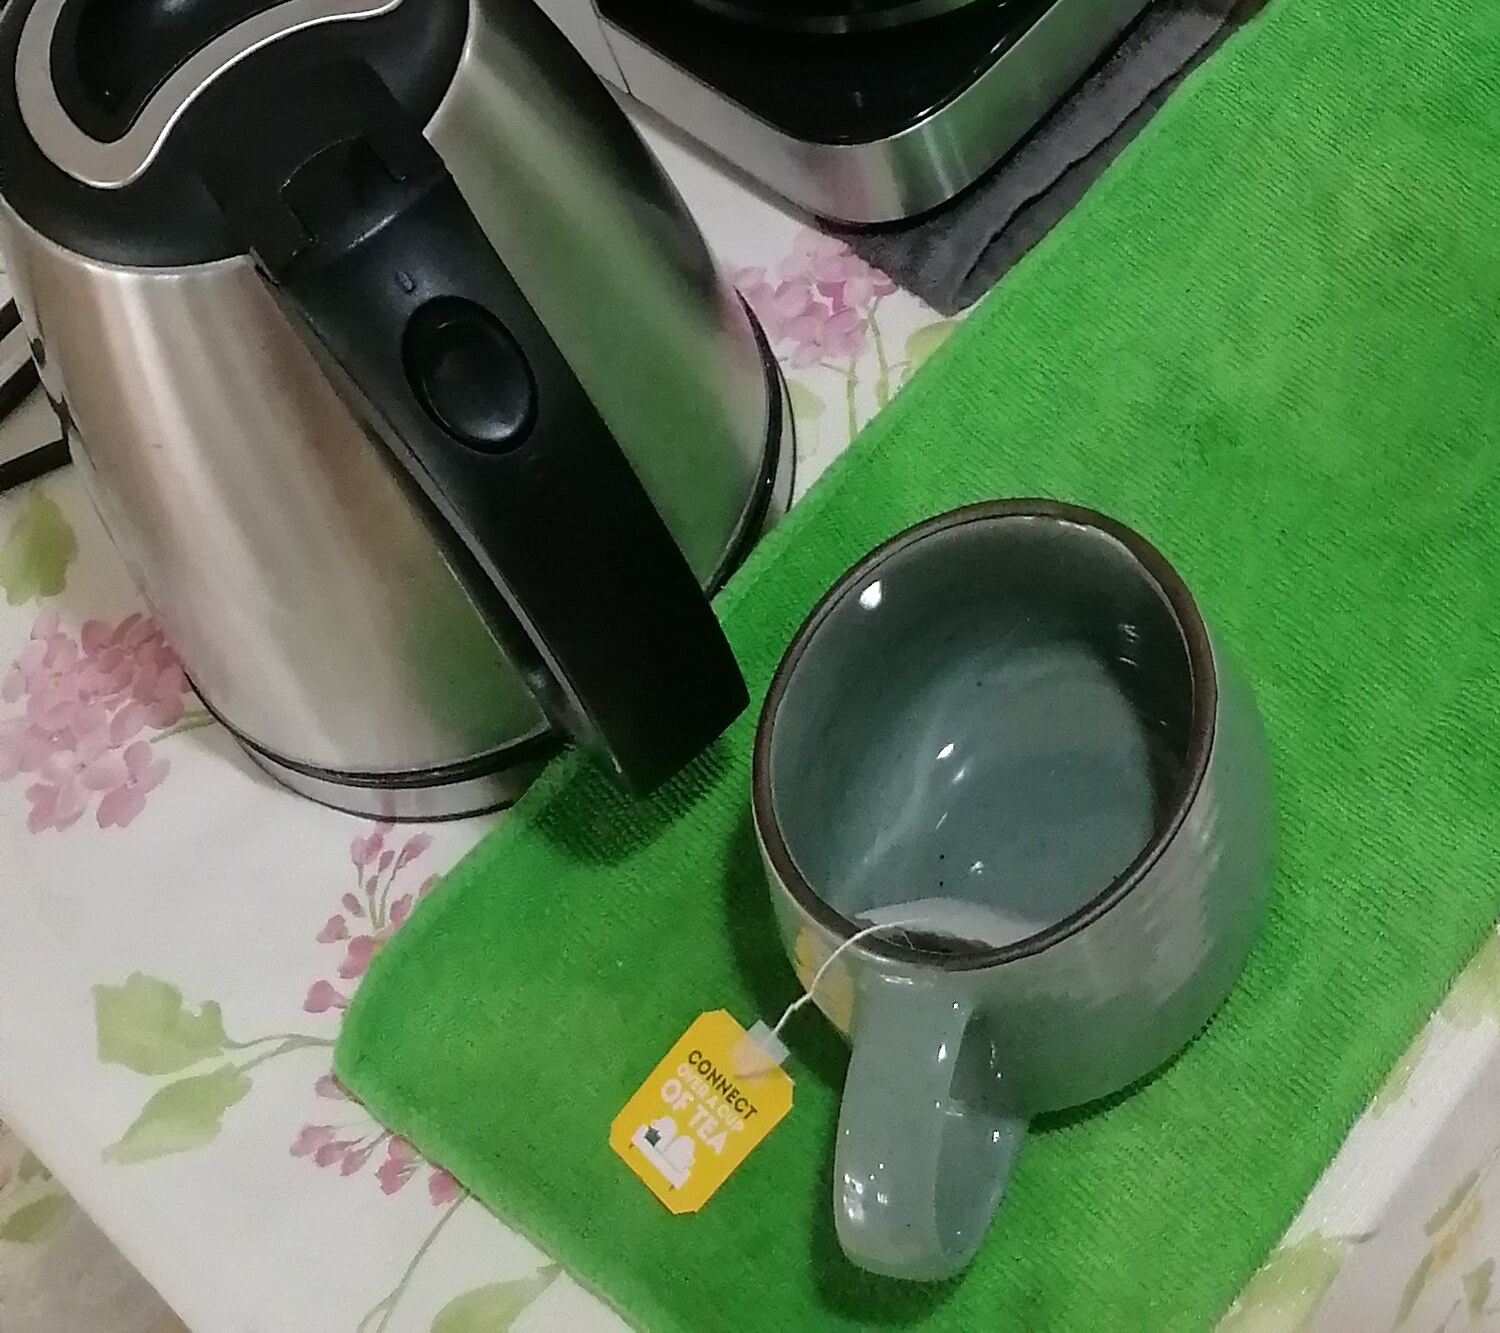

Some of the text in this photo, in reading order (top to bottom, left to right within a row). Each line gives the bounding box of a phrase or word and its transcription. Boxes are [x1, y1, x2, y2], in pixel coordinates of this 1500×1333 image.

[661, 1078, 728, 1155] OF TEA
[688, 1050, 757, 1120] CONNECT
